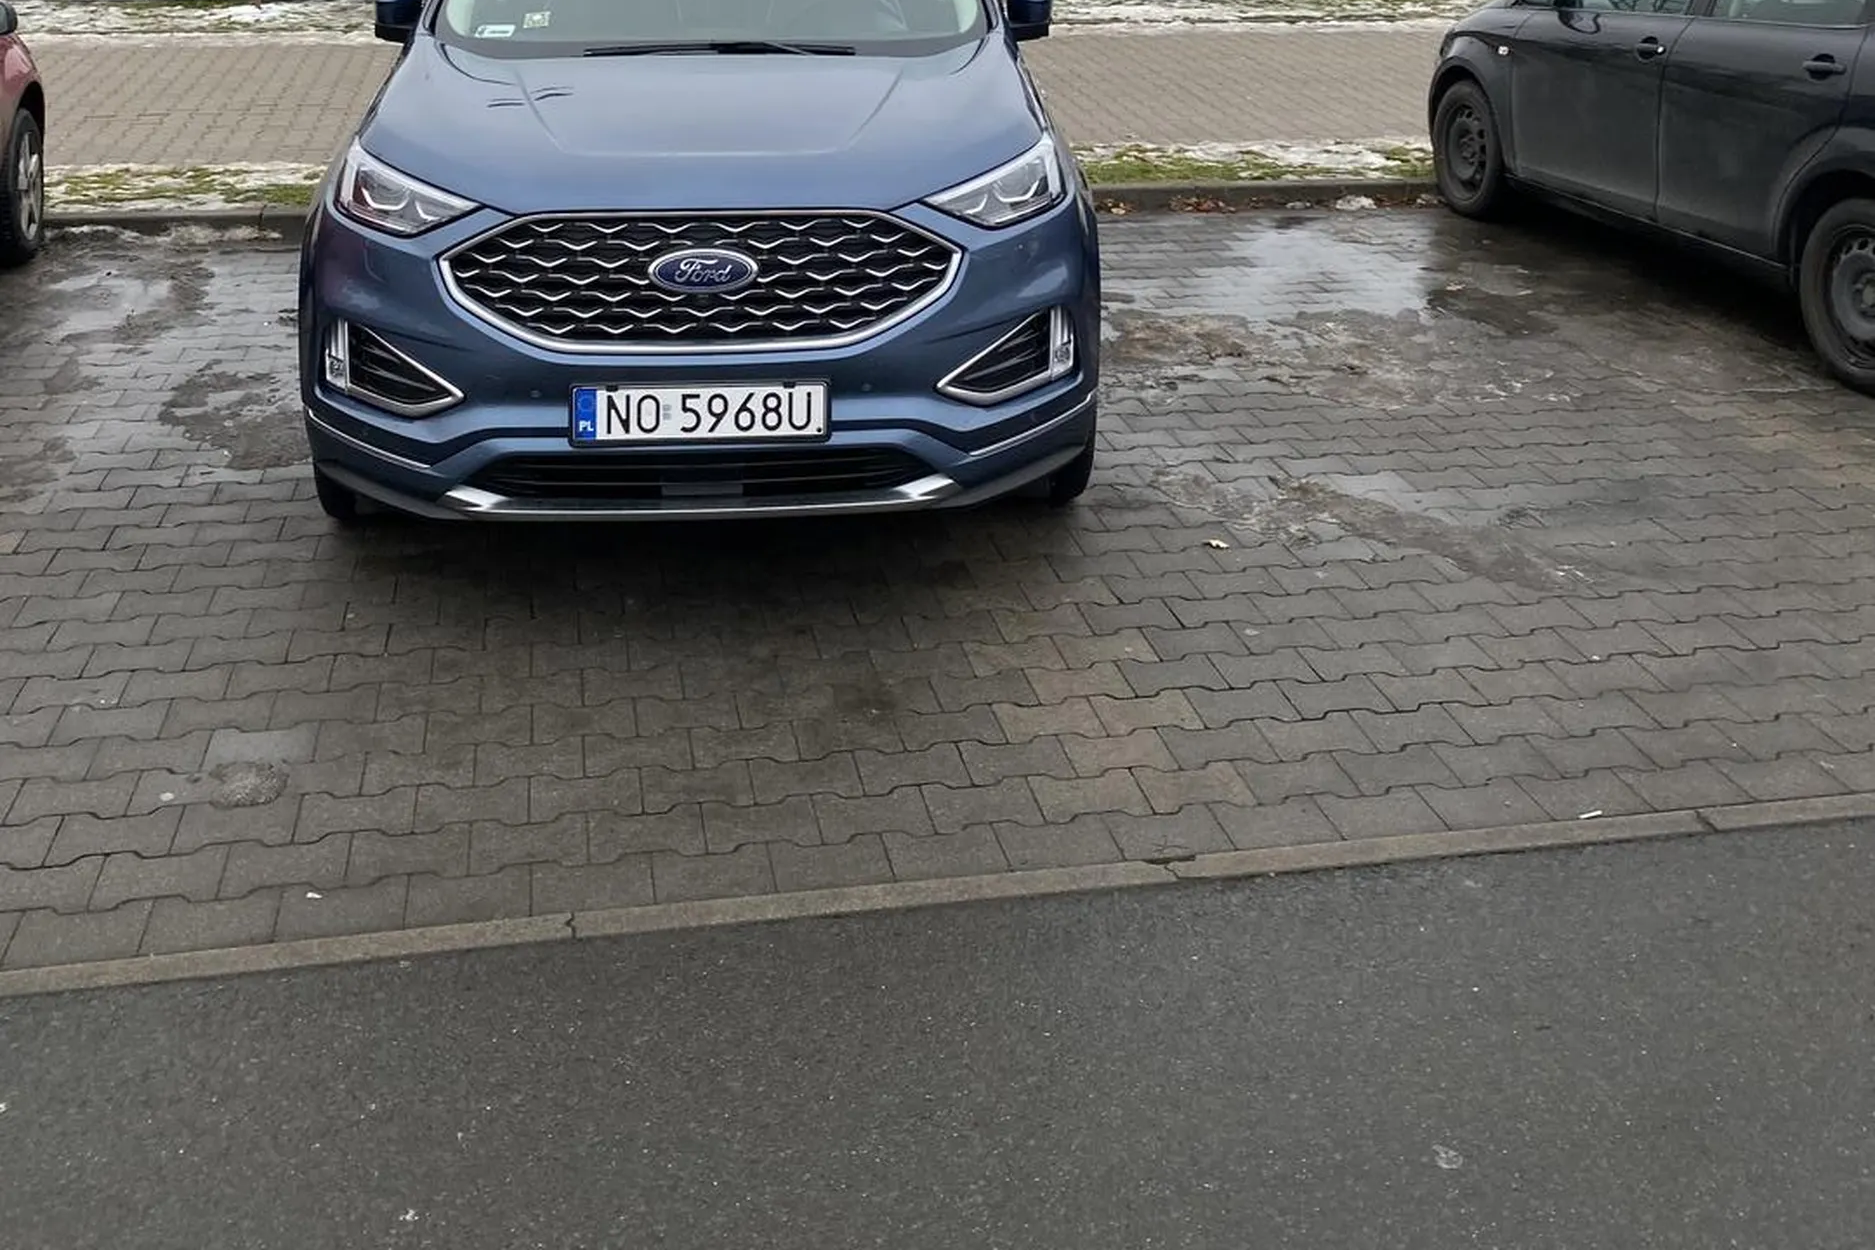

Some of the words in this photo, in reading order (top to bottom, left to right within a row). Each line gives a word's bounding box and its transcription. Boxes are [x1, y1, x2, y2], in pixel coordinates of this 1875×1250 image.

[675, 258, 732, 282] Ford
[606, 394, 660, 435] NO
[680, 392, 812, 434] 5968U
[579, 421, 594, 432] PL
